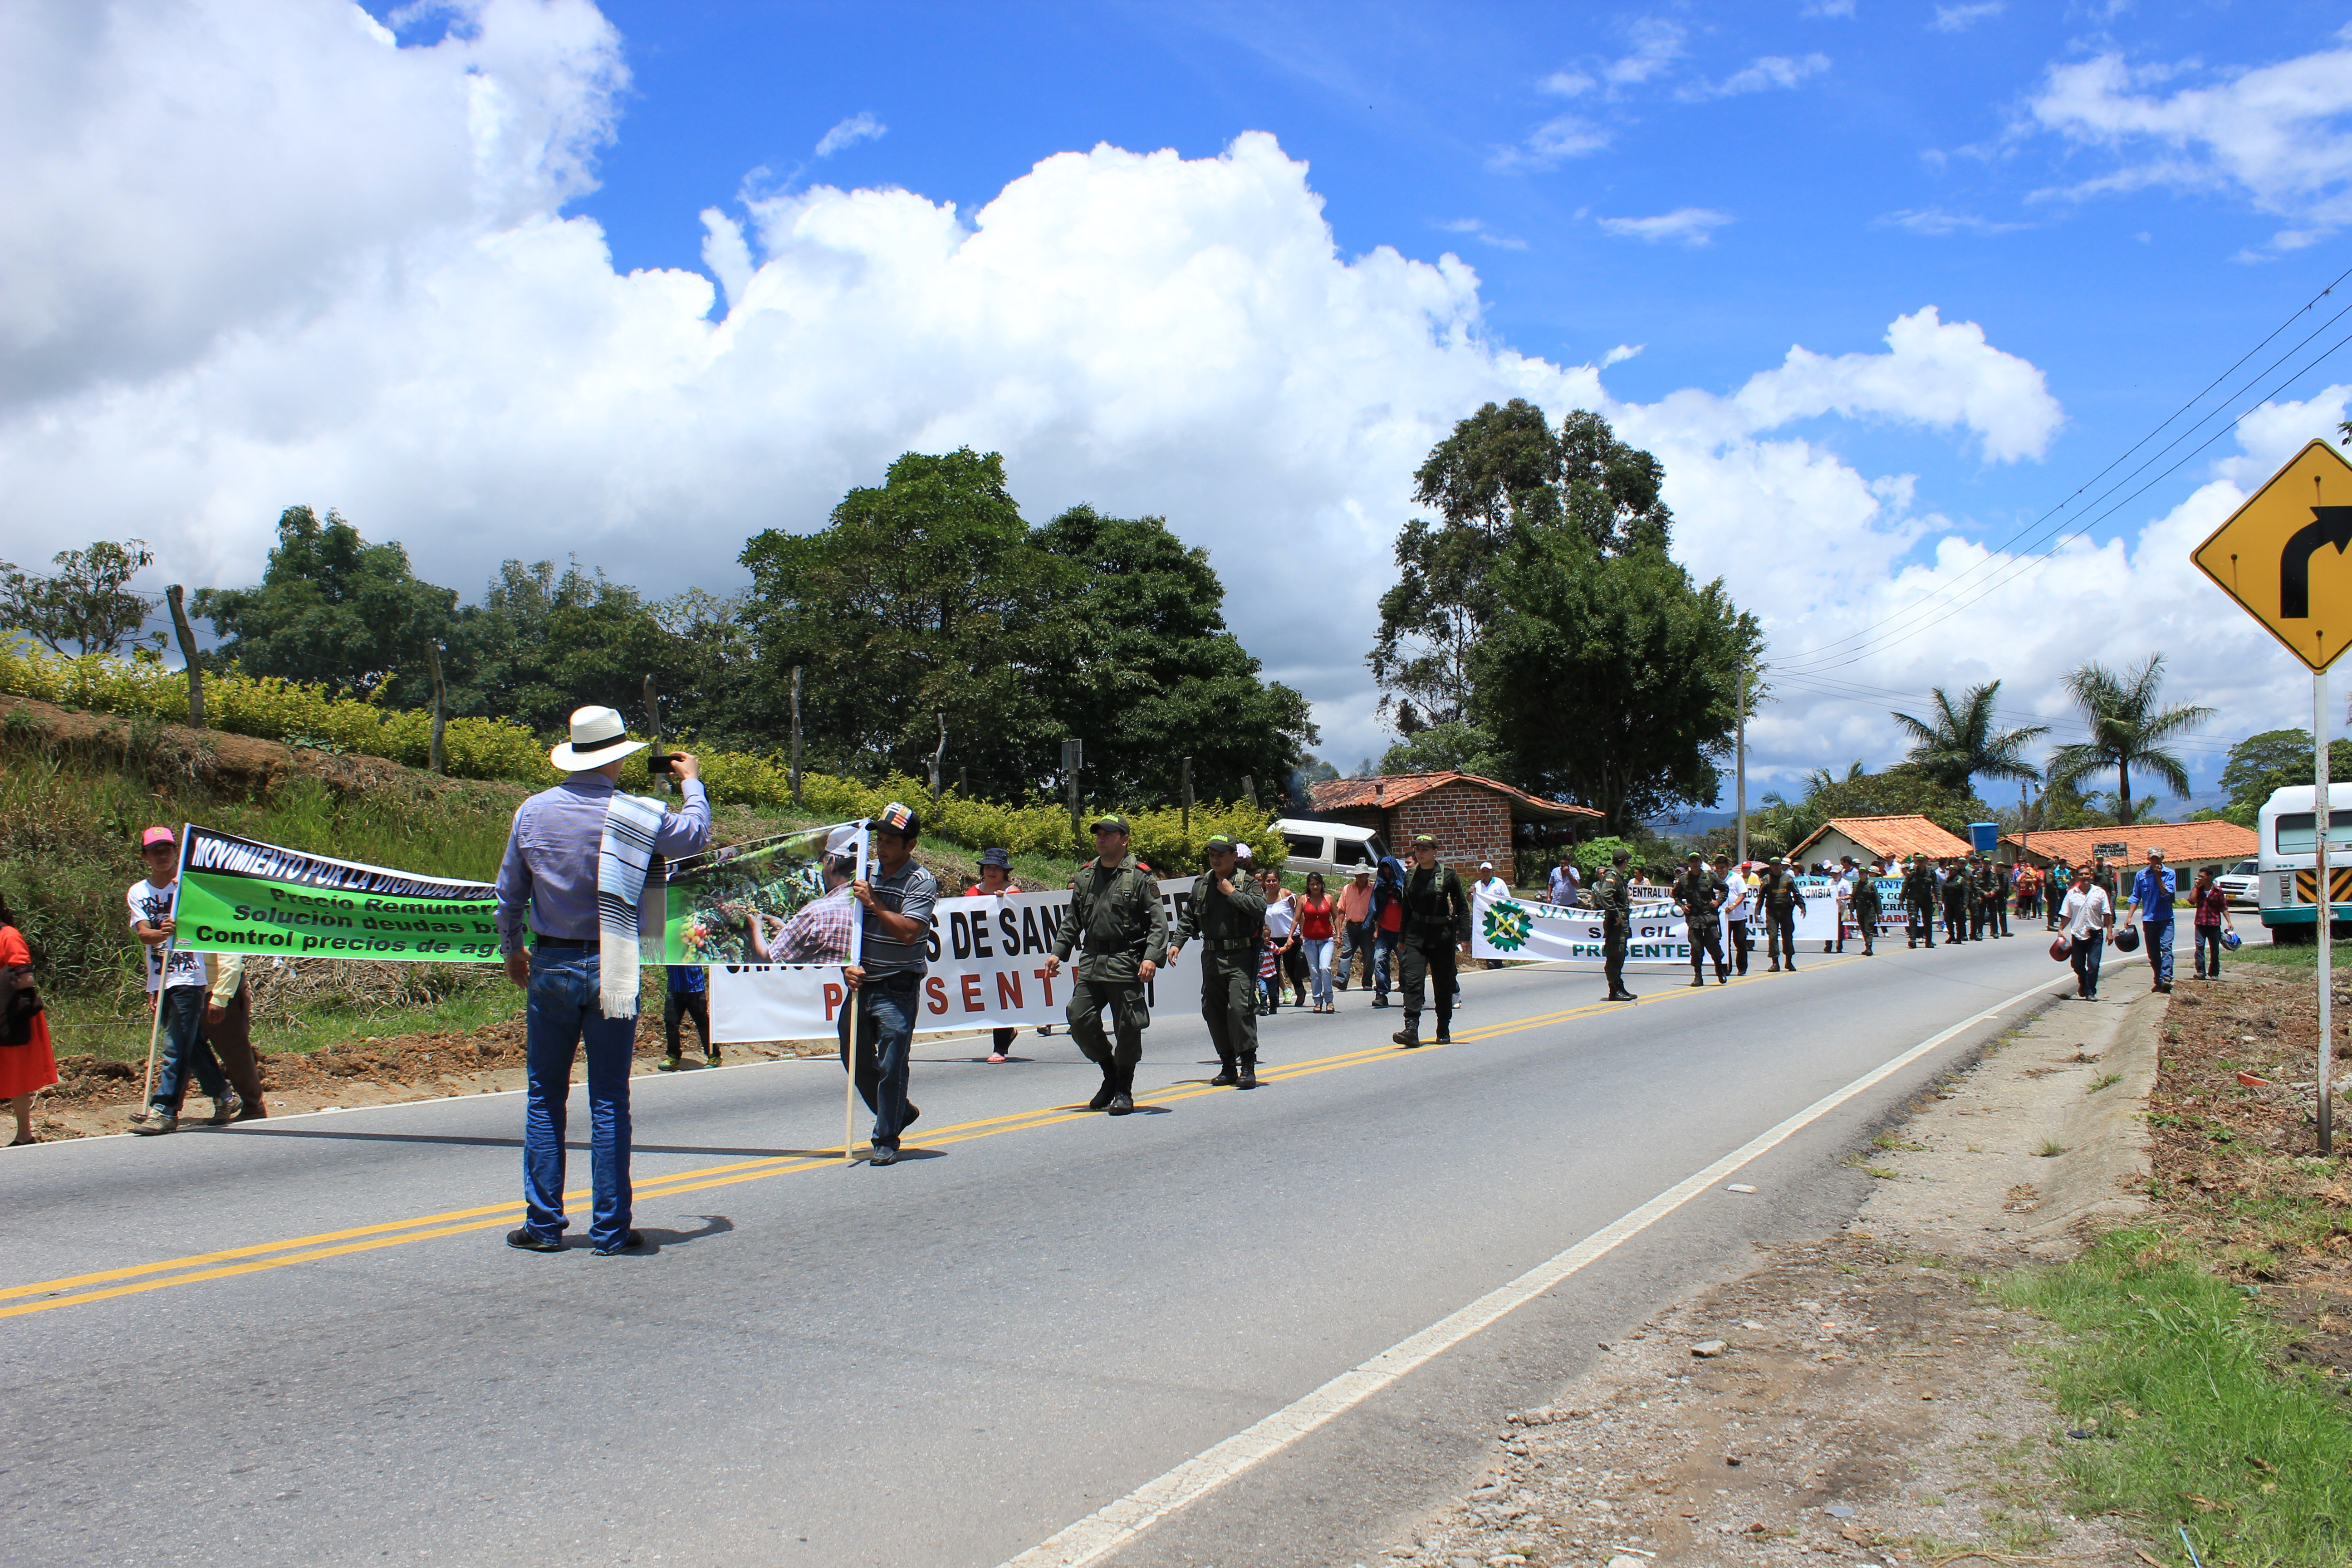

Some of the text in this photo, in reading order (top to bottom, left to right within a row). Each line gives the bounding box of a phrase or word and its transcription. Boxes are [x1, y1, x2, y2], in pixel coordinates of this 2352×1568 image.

[191, 837, 307, 880] MOVIMIENTO
[302, 861, 347, 886] POR
[343, 868, 372, 890] LA
[370, 874, 463, 897] DIGNIDAD
[270, 888, 354, 911] Precio
[1628, 886, 1662, 898] CENTRAL
[233, 905, 353, 928] Solución
[362, 916, 465, 934] deudas
[1641, 926, 1676, 938] GIL
[196, 925, 294, 947] Control
[301, 936, 407, 952] precios
[416, 939, 451, 954] de
[950, 910, 994, 960] DE
